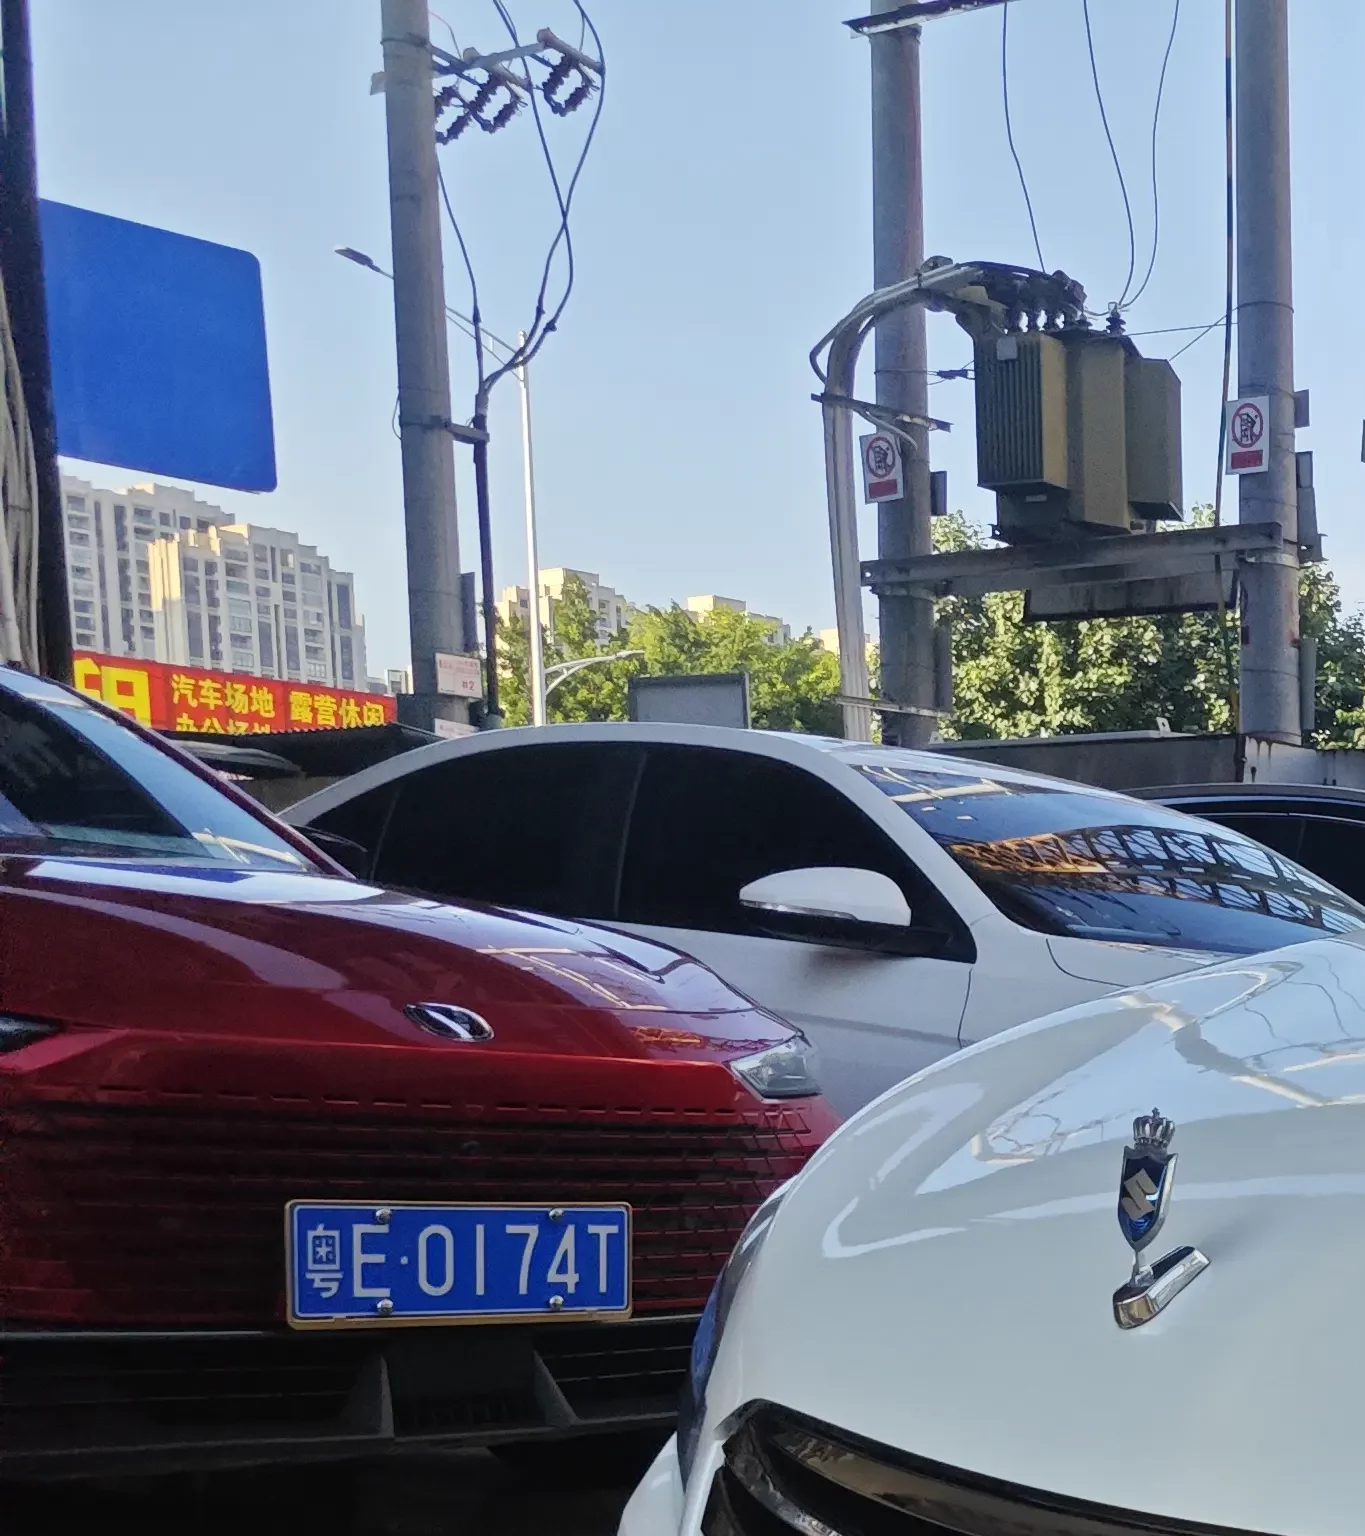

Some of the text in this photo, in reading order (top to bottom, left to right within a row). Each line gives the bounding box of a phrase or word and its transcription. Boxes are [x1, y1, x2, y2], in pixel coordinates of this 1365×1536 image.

[171, 673, 276, 718] 汽车场地
[289, 690, 385, 728] 露营休闲
